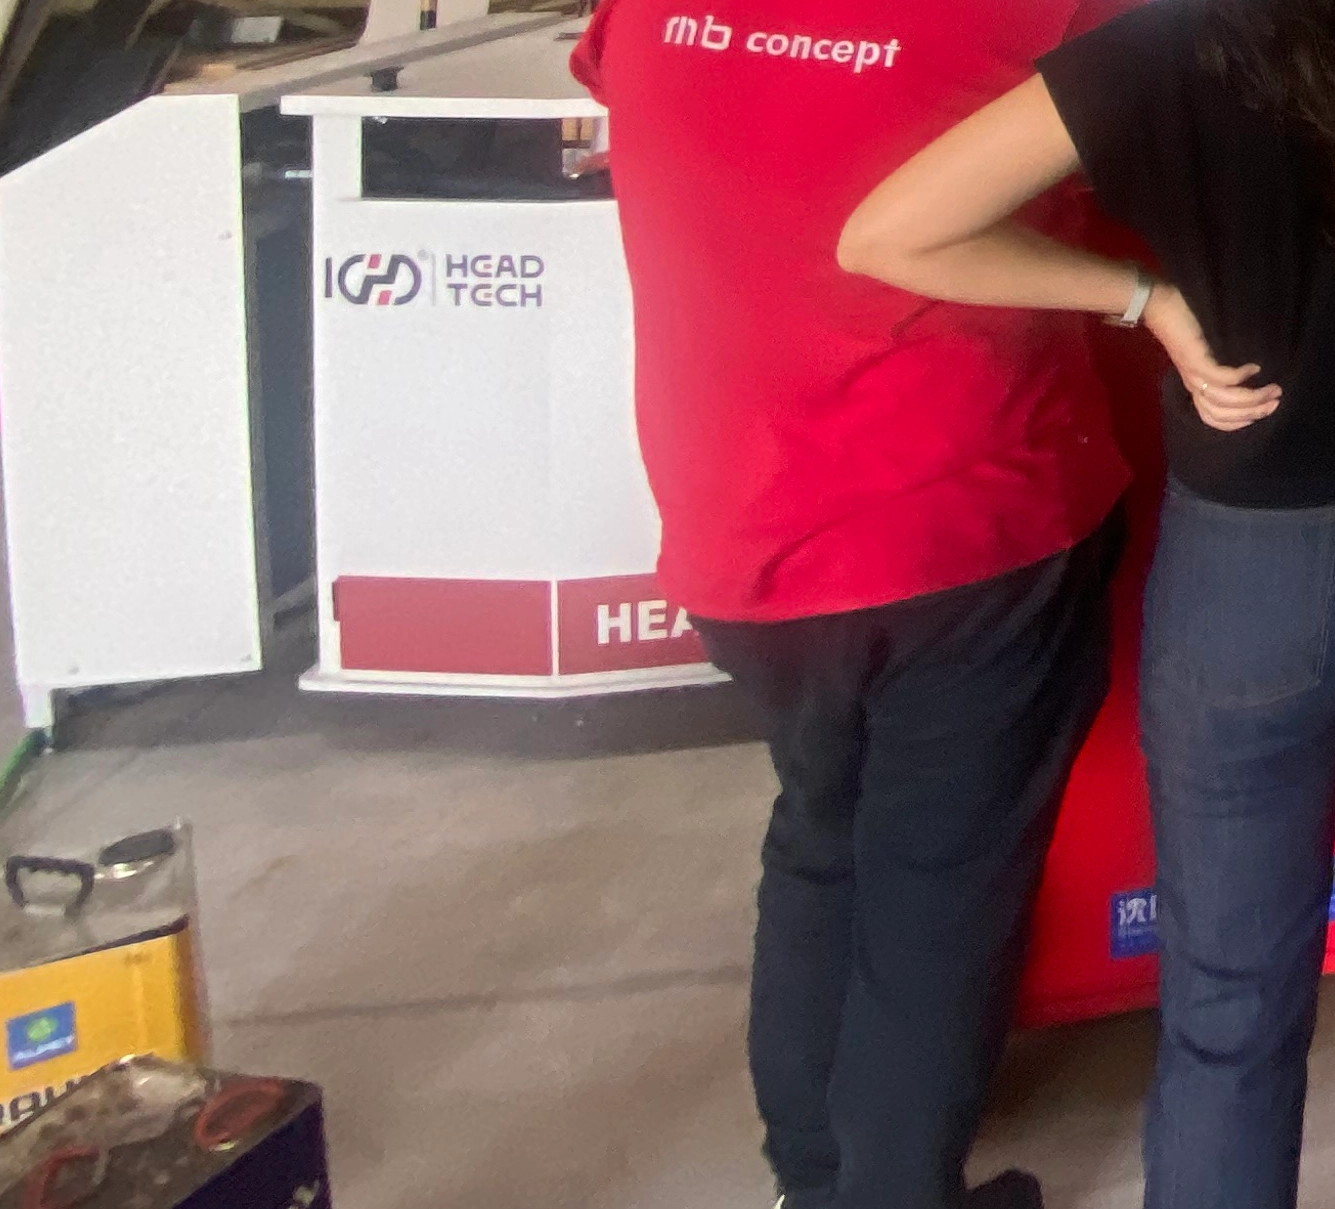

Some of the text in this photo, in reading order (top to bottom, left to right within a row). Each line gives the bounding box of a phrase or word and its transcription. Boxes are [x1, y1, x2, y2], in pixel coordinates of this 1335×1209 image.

[663, 15, 902, 74] mb concept
[446, 253, 545, 278] HEAD
[446, 283, 542, 307] TECH
